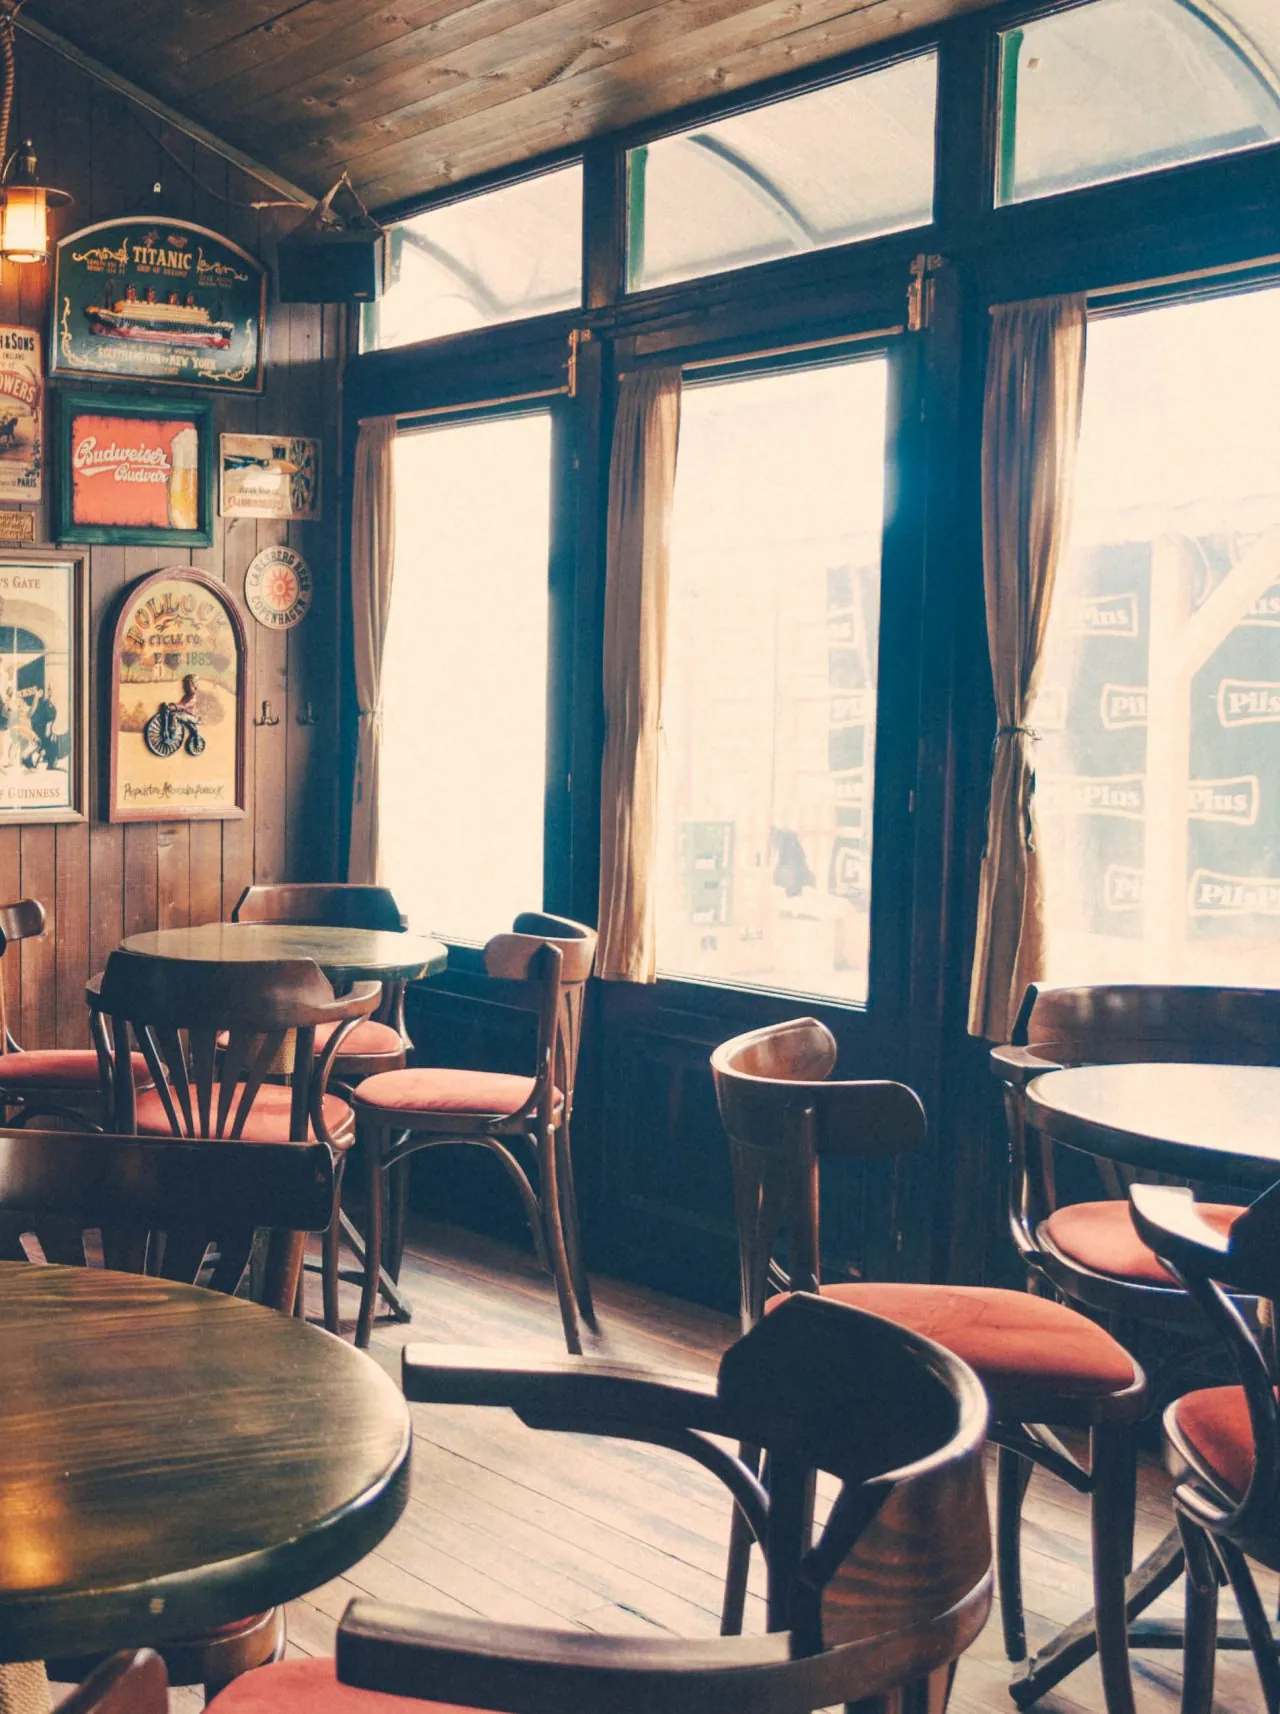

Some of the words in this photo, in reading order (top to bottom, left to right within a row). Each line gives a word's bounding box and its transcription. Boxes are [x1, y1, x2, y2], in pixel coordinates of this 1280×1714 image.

[133, 246, 192, 269] TITANIC
[12, 333, 34, 351] SONS
[73, 436, 171, 468] Budweiser
[114, 462, 169, 484] Budvar
[13, 575, 41, 589] GATE
[1111, 695, 1147, 717] Pil
[7, 786, 60, 799] GUINNESS
